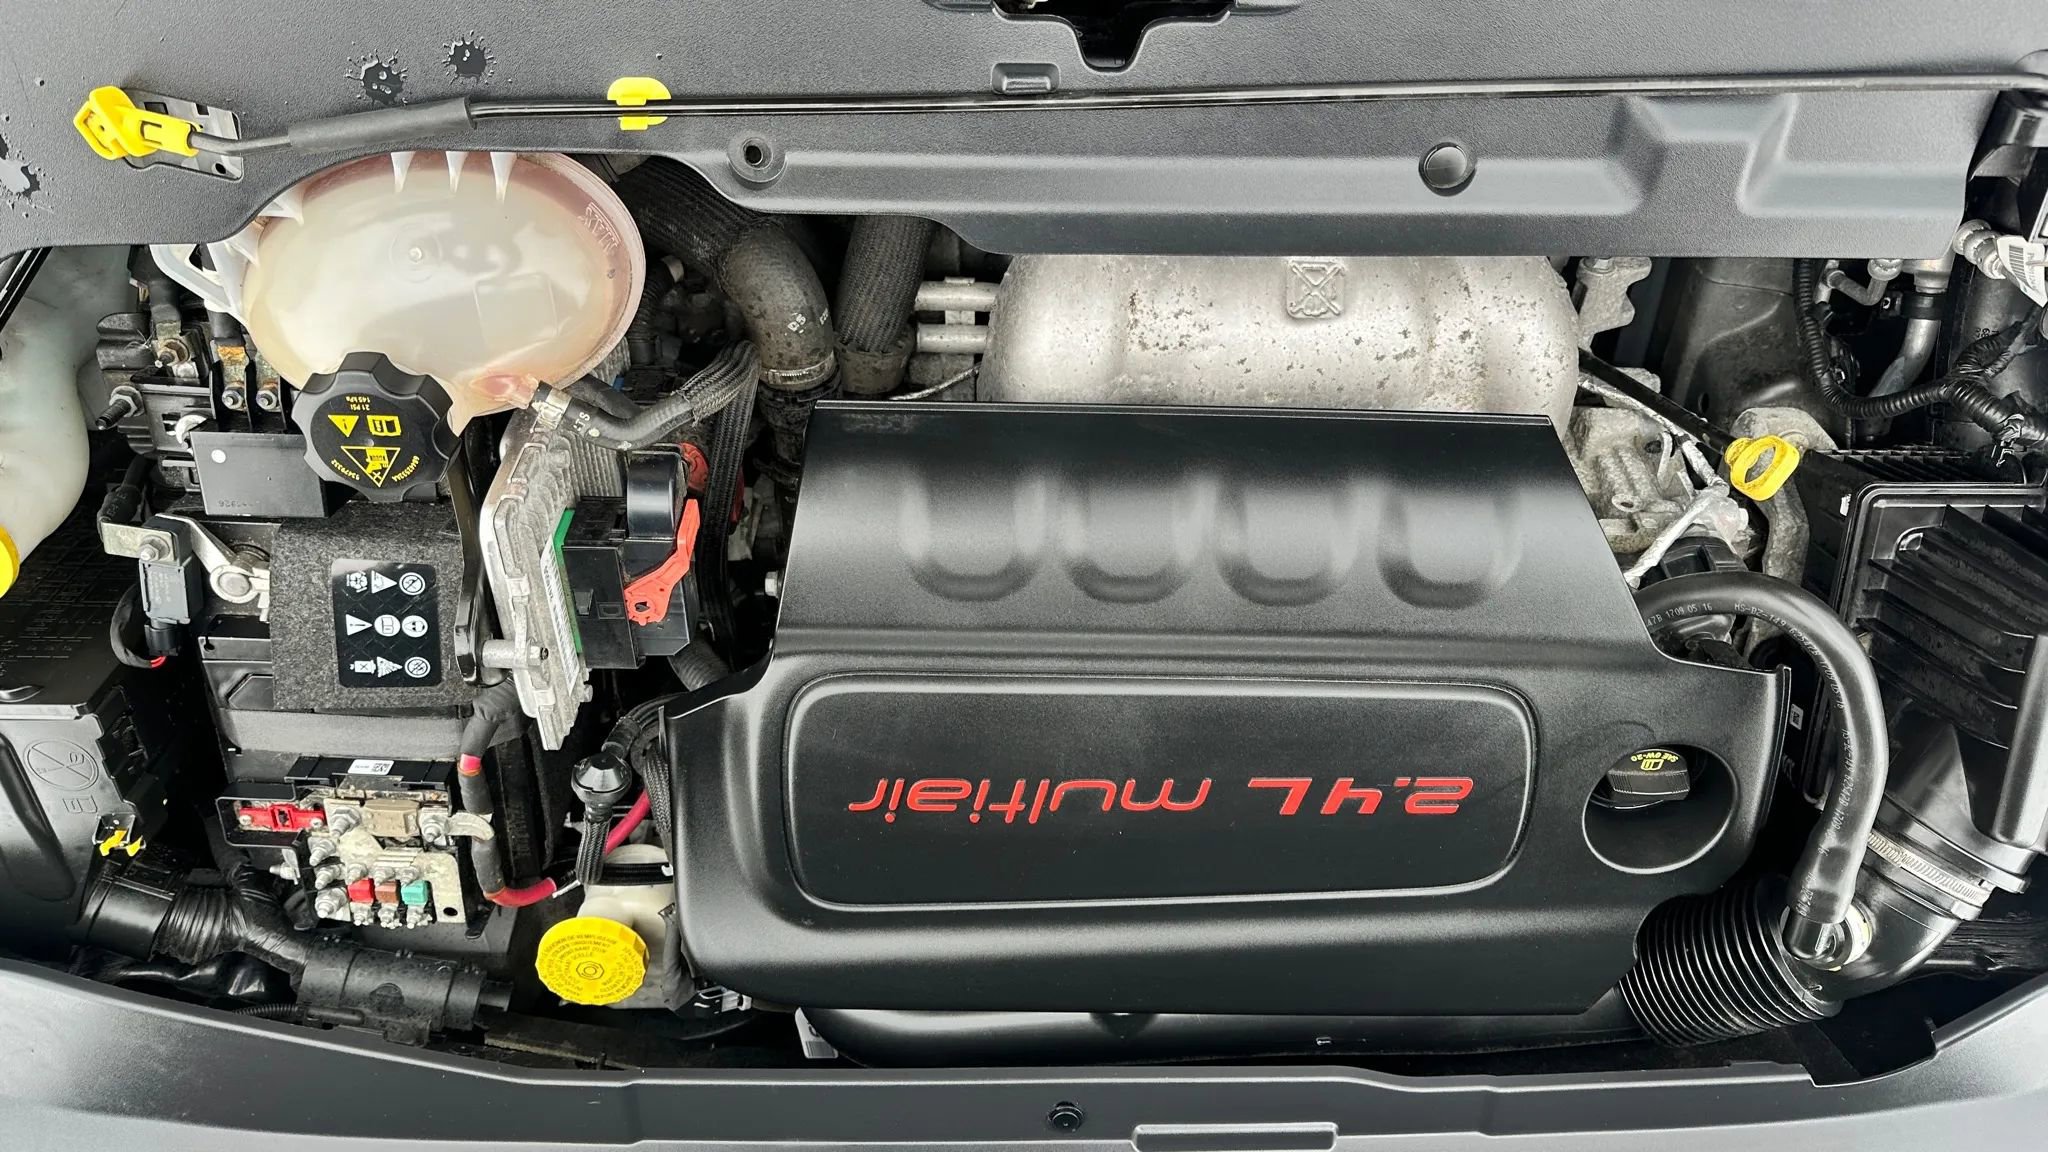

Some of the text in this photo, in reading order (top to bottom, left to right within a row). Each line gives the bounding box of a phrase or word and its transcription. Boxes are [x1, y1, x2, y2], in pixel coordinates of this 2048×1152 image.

[1687, 603, 1698, 613] 05
[1702, 603, 1713, 611] 16
[1630, 752, 1679, 762] SAE 0W-20
[848, 776, 1475, 825] 2.4L multiair
